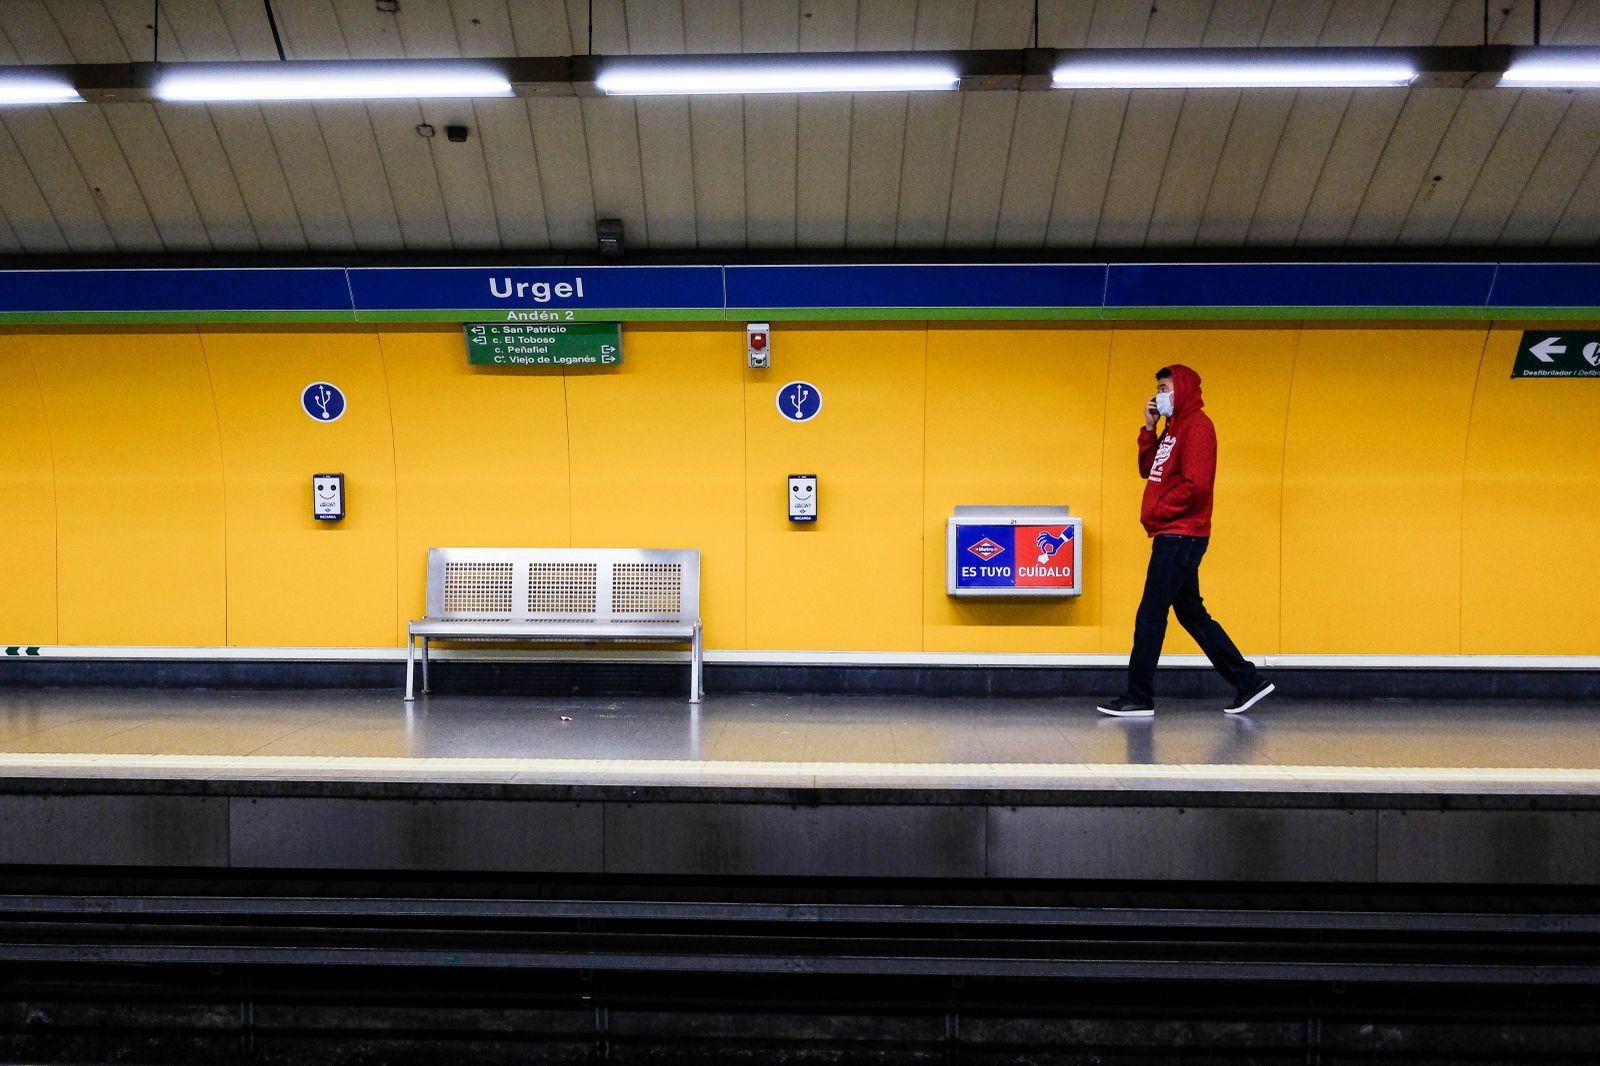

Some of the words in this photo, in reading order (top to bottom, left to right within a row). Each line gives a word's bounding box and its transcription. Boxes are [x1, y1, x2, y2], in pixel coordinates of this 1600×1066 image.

[489, 277, 584, 303] Urgel
[507, 310, 558, 320] Andén
[565, 310, 574, 320] 2
[503, 326, 523, 334] San
[526, 326, 567, 334] Patricio
[504, 336, 515, 344] El
[517, 336, 556, 344] Toboso
[507, 346, 548, 354] Peñafiel
[509, 355, 535, 365] Viejo
[553, 355, 597, 365] Leganés
[961, 566, 977, 577] ES
[980, 566, 1011, 577] TUYO
[1018, 564, 1071, 577] CUÍDALO
